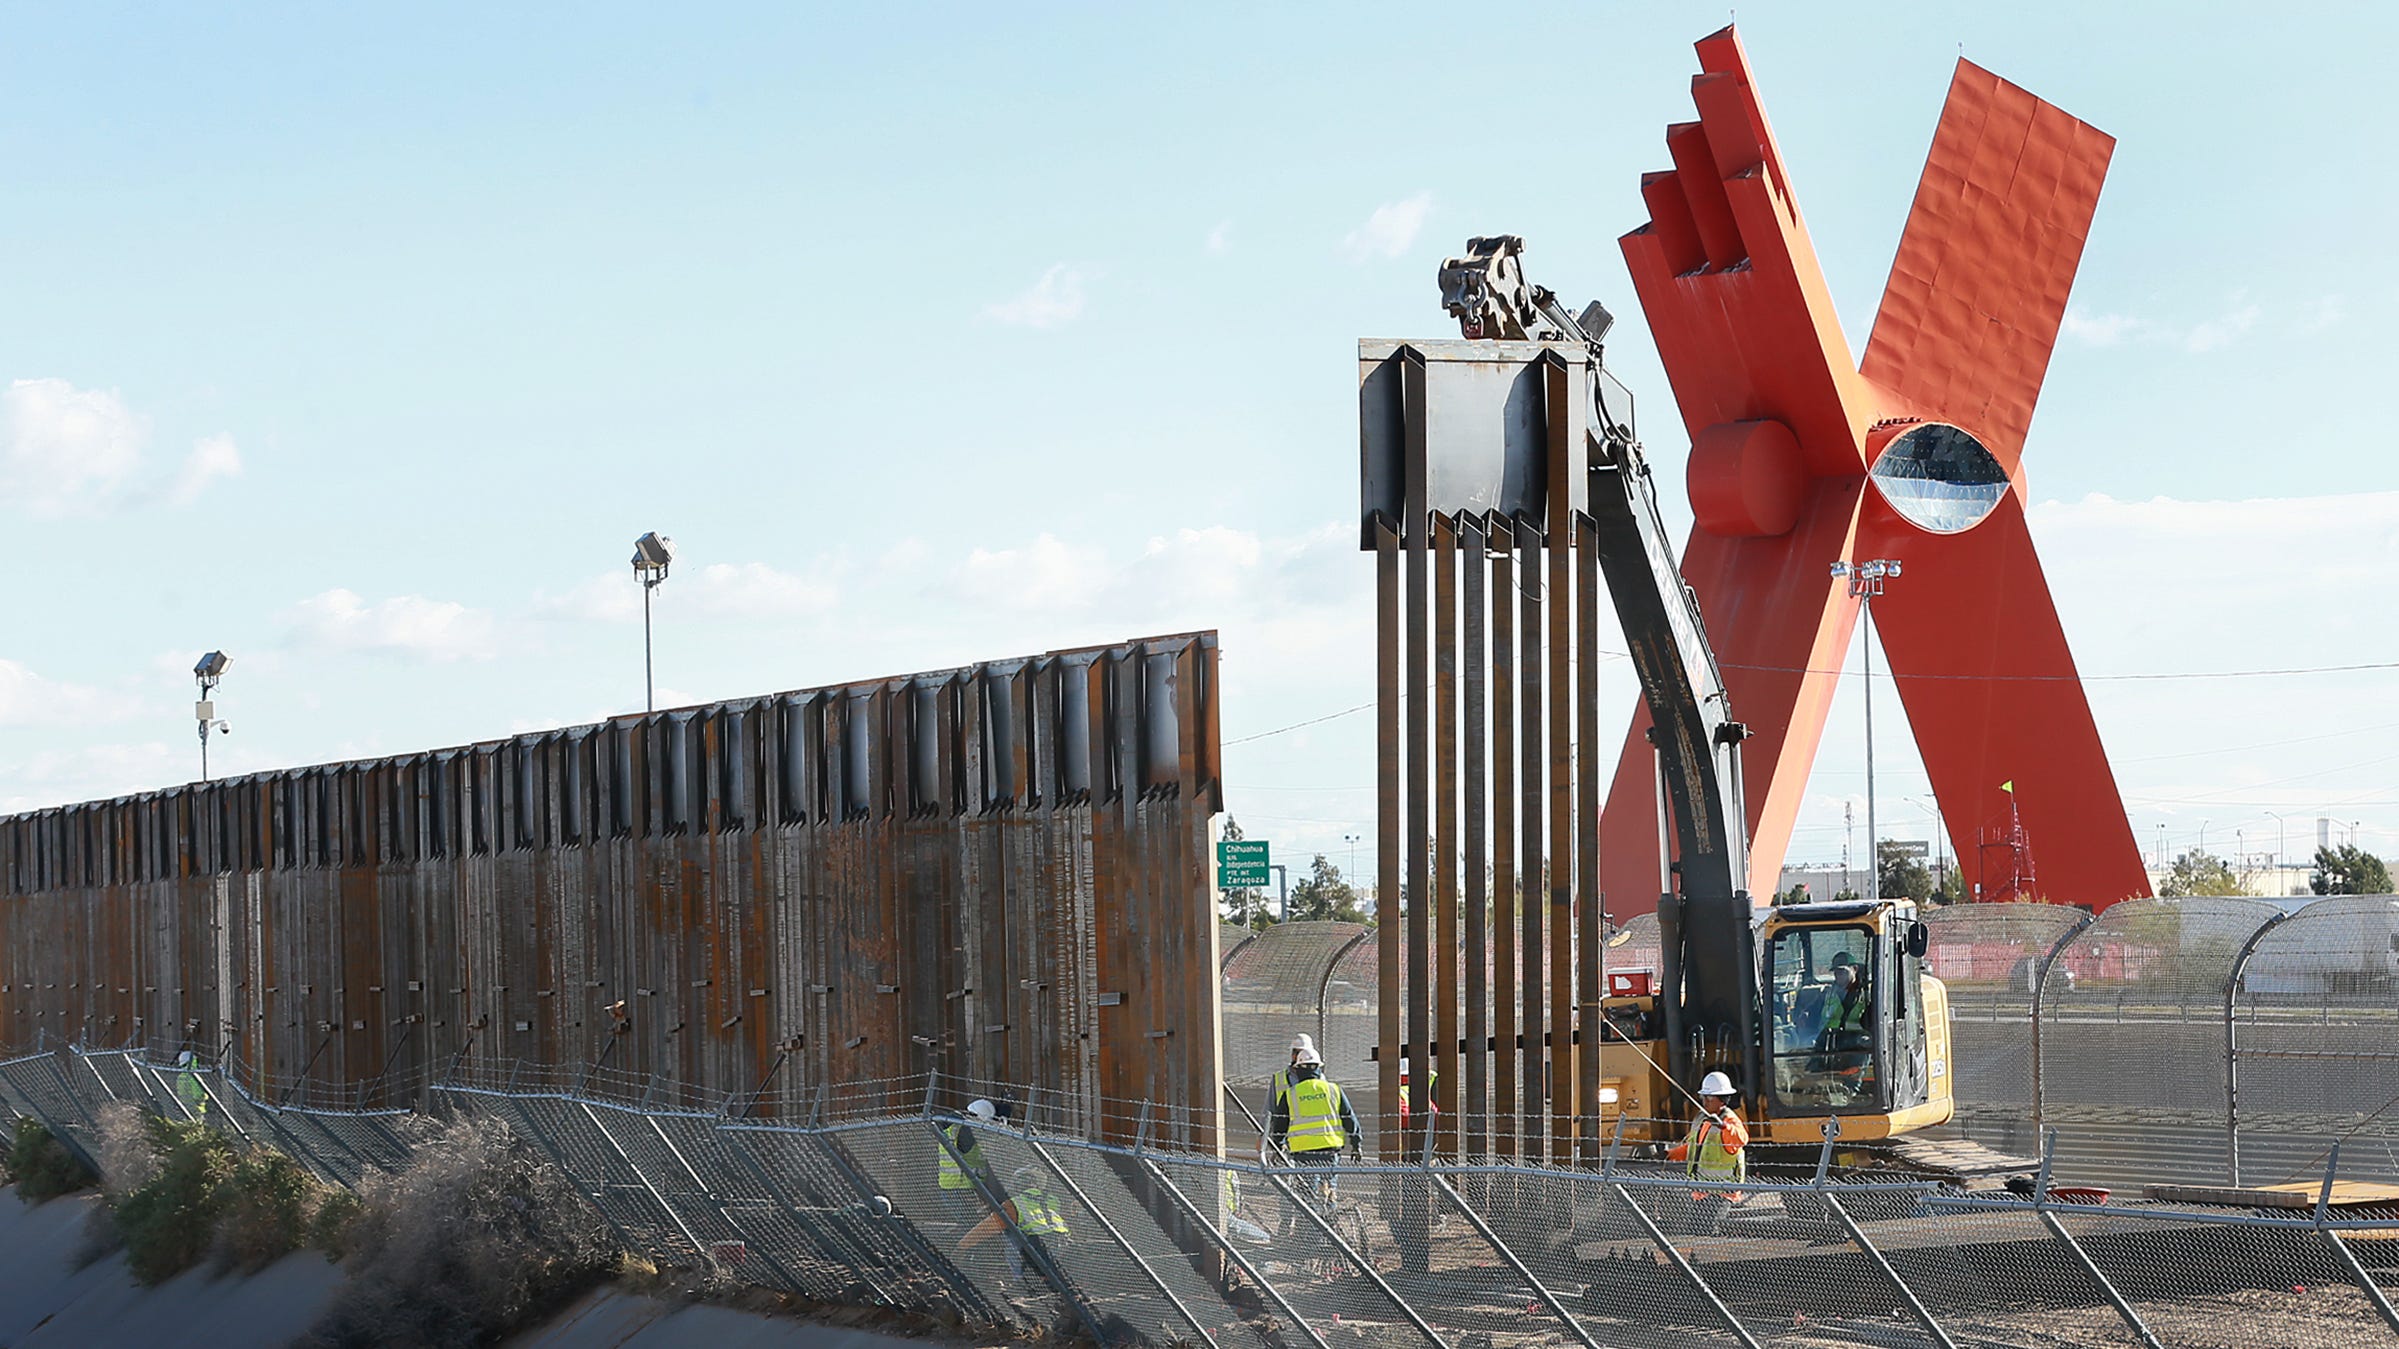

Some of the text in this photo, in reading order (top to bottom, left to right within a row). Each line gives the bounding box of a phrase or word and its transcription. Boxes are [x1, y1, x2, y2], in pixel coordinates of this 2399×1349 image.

[1648, 528, 1688, 652] DEERE
[1226, 844, 1264, 853] Chihuahua
[1226, 861, 1265, 869] Independencia
[1227, 876, 1265, 885] Zaragoza
